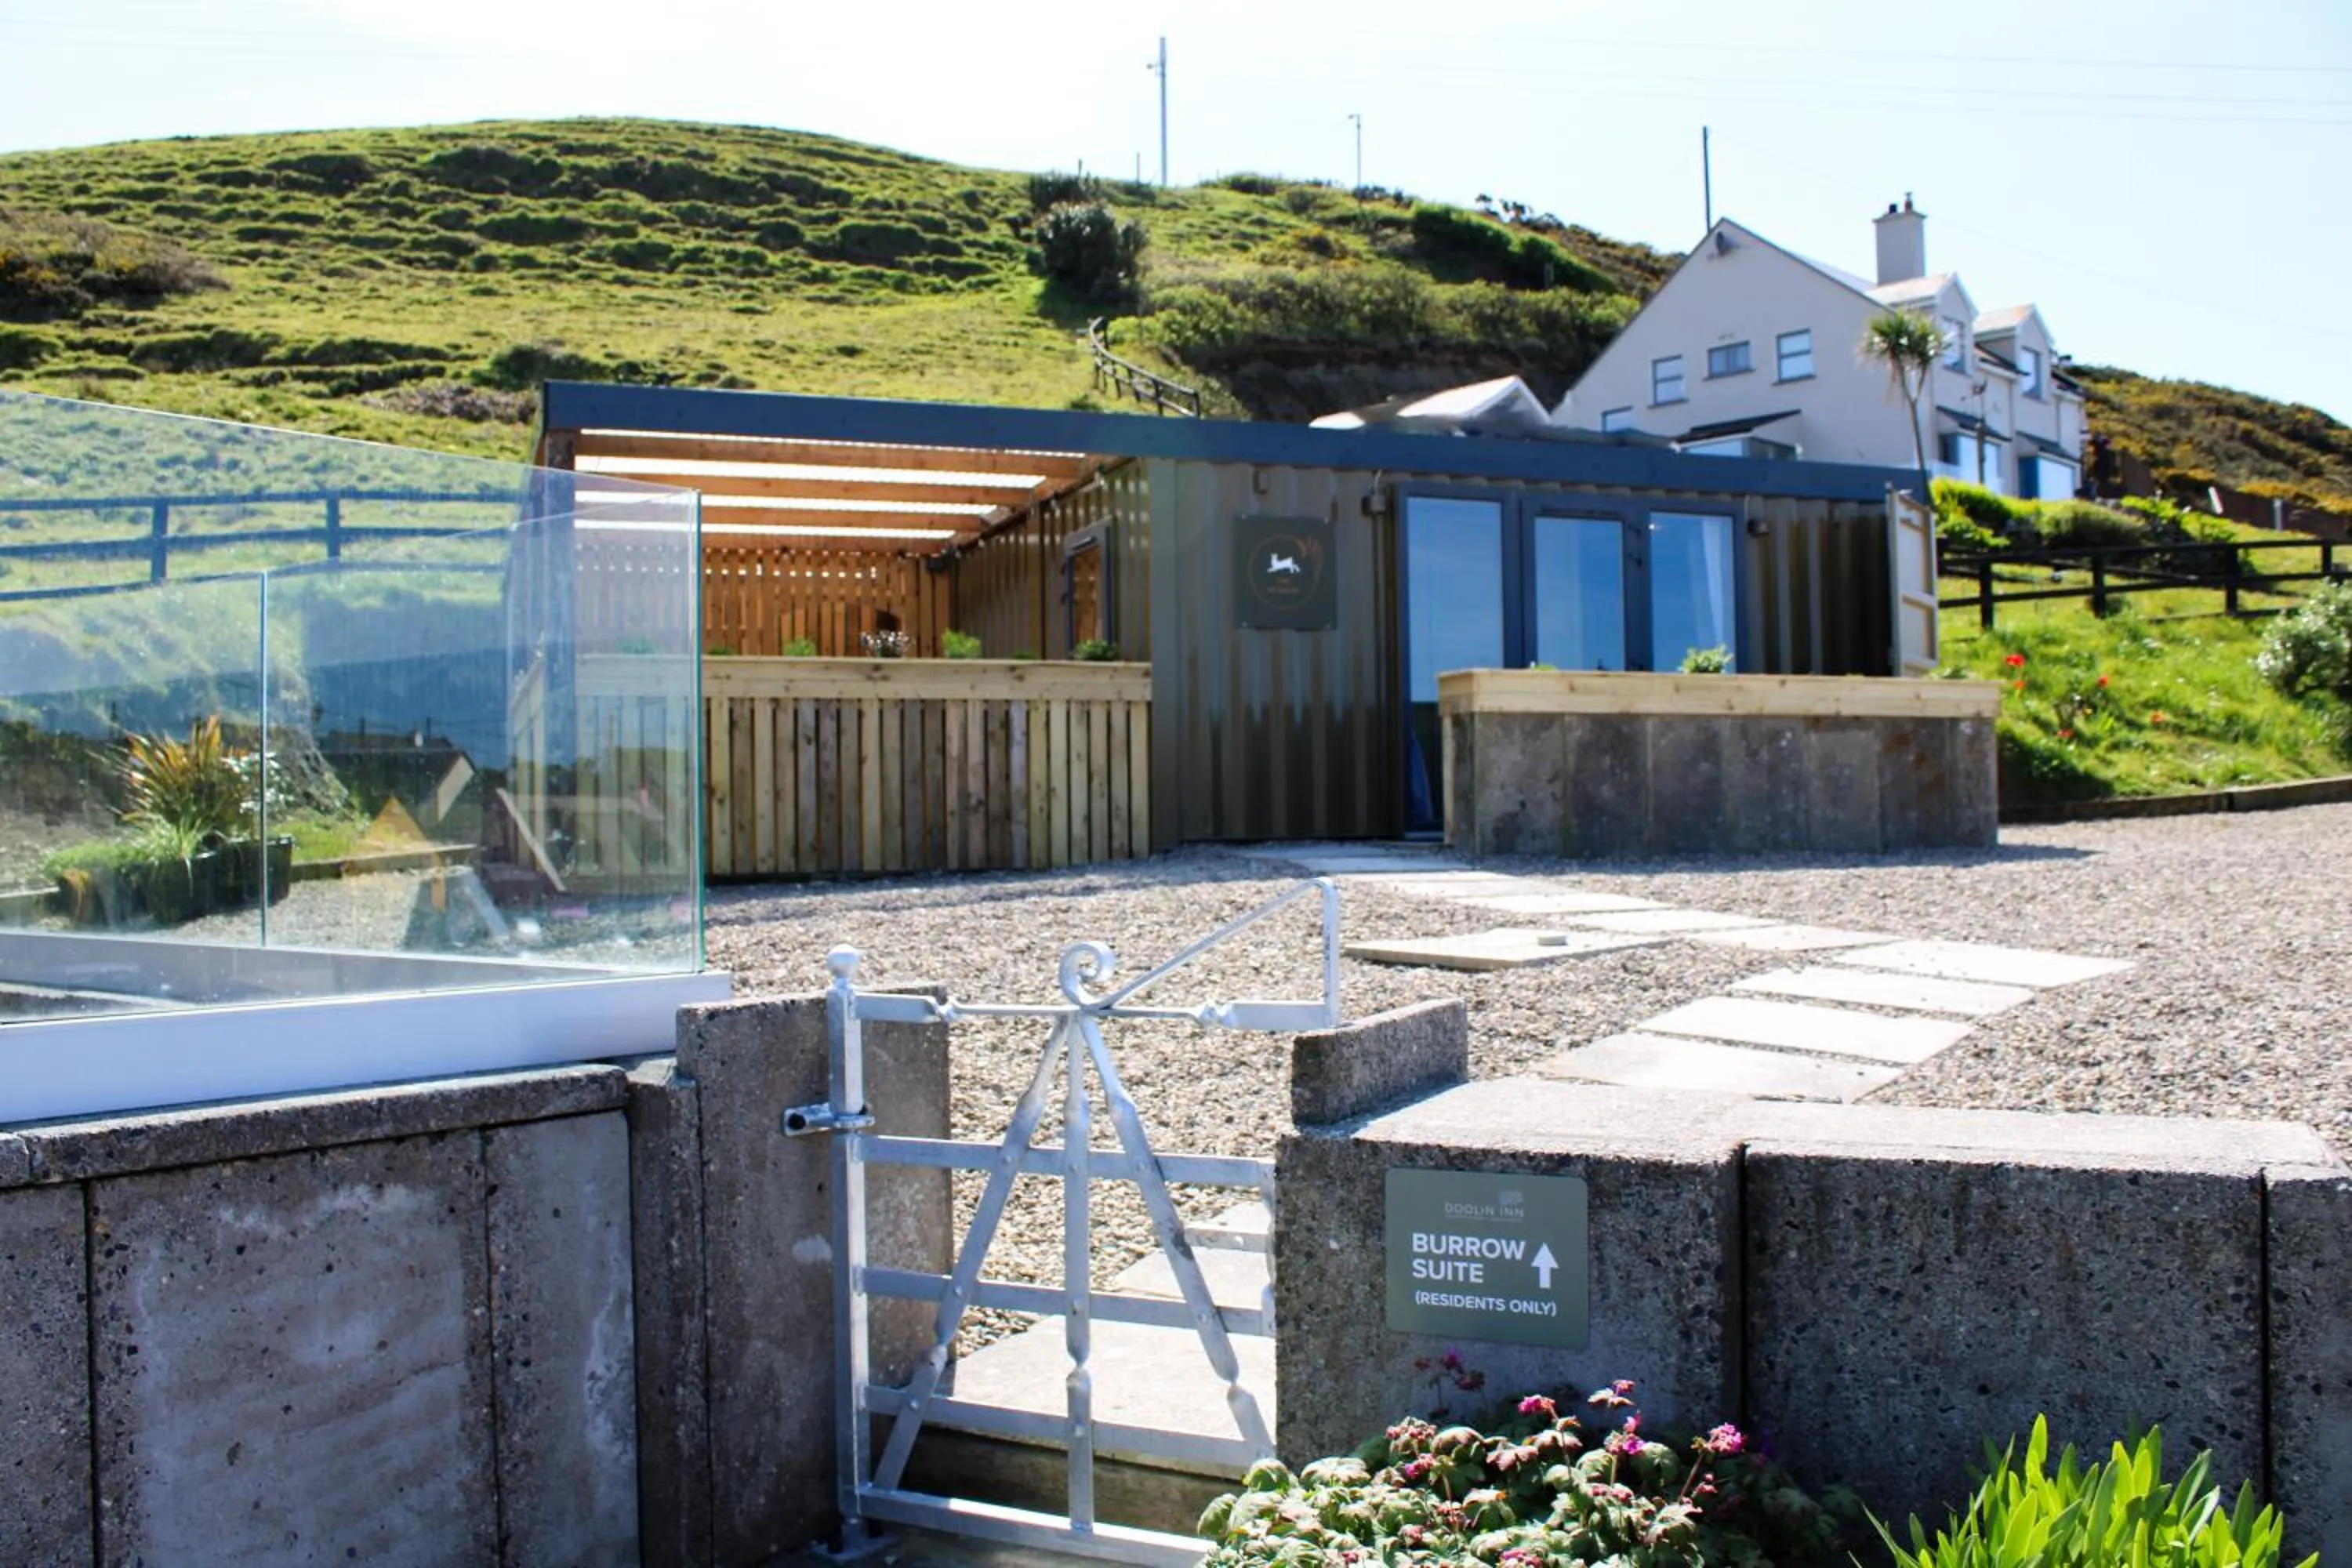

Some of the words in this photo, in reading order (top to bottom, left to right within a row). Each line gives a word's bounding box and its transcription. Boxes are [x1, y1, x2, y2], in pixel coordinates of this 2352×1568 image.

[1444, 1202, 1494, 1216] DOOLIN
[1499, 1205, 1524, 1218] INN
[1412, 1232, 1526, 1261] BURROW
[1412, 1258, 1484, 1283] SUITE
[1414, 1290, 1506, 1312] (RESIDENTS
[1510, 1299, 1557, 1317] ONLY)
